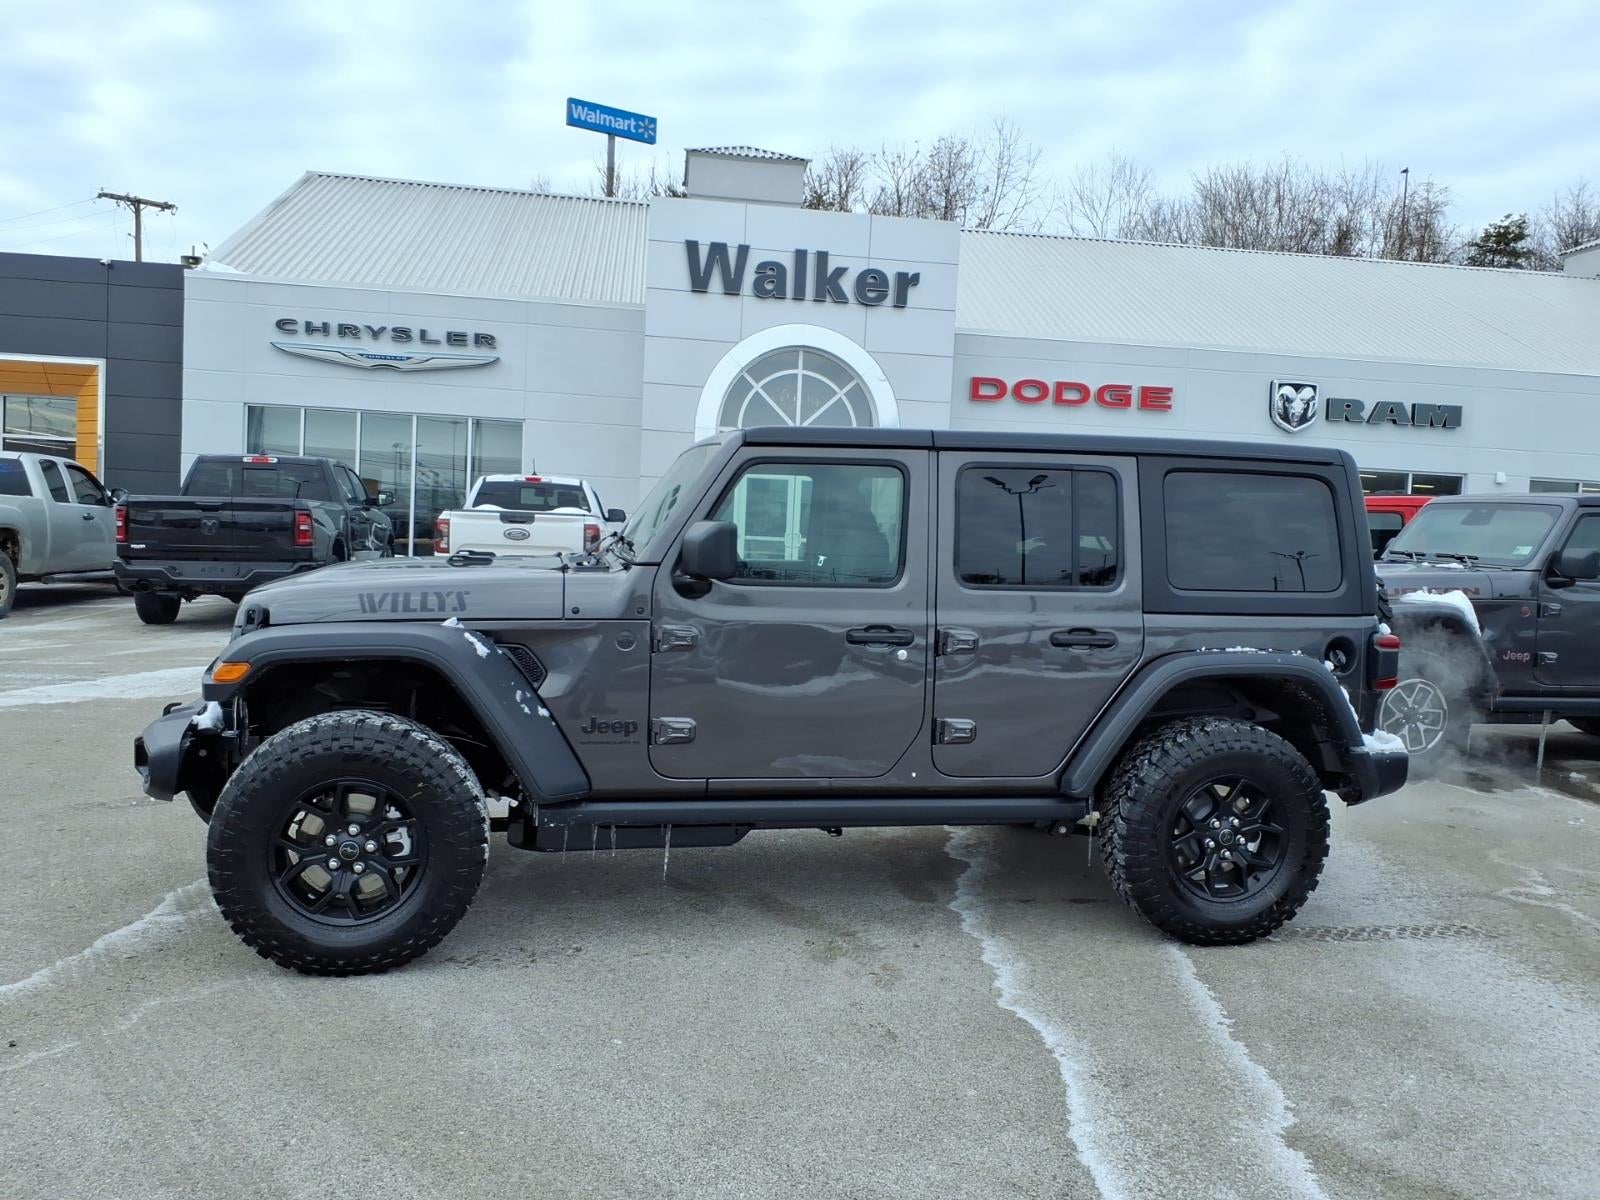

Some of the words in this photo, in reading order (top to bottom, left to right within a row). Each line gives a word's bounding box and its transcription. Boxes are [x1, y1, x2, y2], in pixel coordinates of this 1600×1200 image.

[571, 103, 637, 133] Walmart
[685, 239, 921, 308] Walker
[275, 318, 497, 349] CHRYSLER
[969, 376, 1174, 411] DODGE
[1325, 397, 1463, 428] RAM
[358, 590, 471, 614] WILLYS
[1502, 650, 1531, 662] Jeep
[580, 715, 639, 738] Jeep
